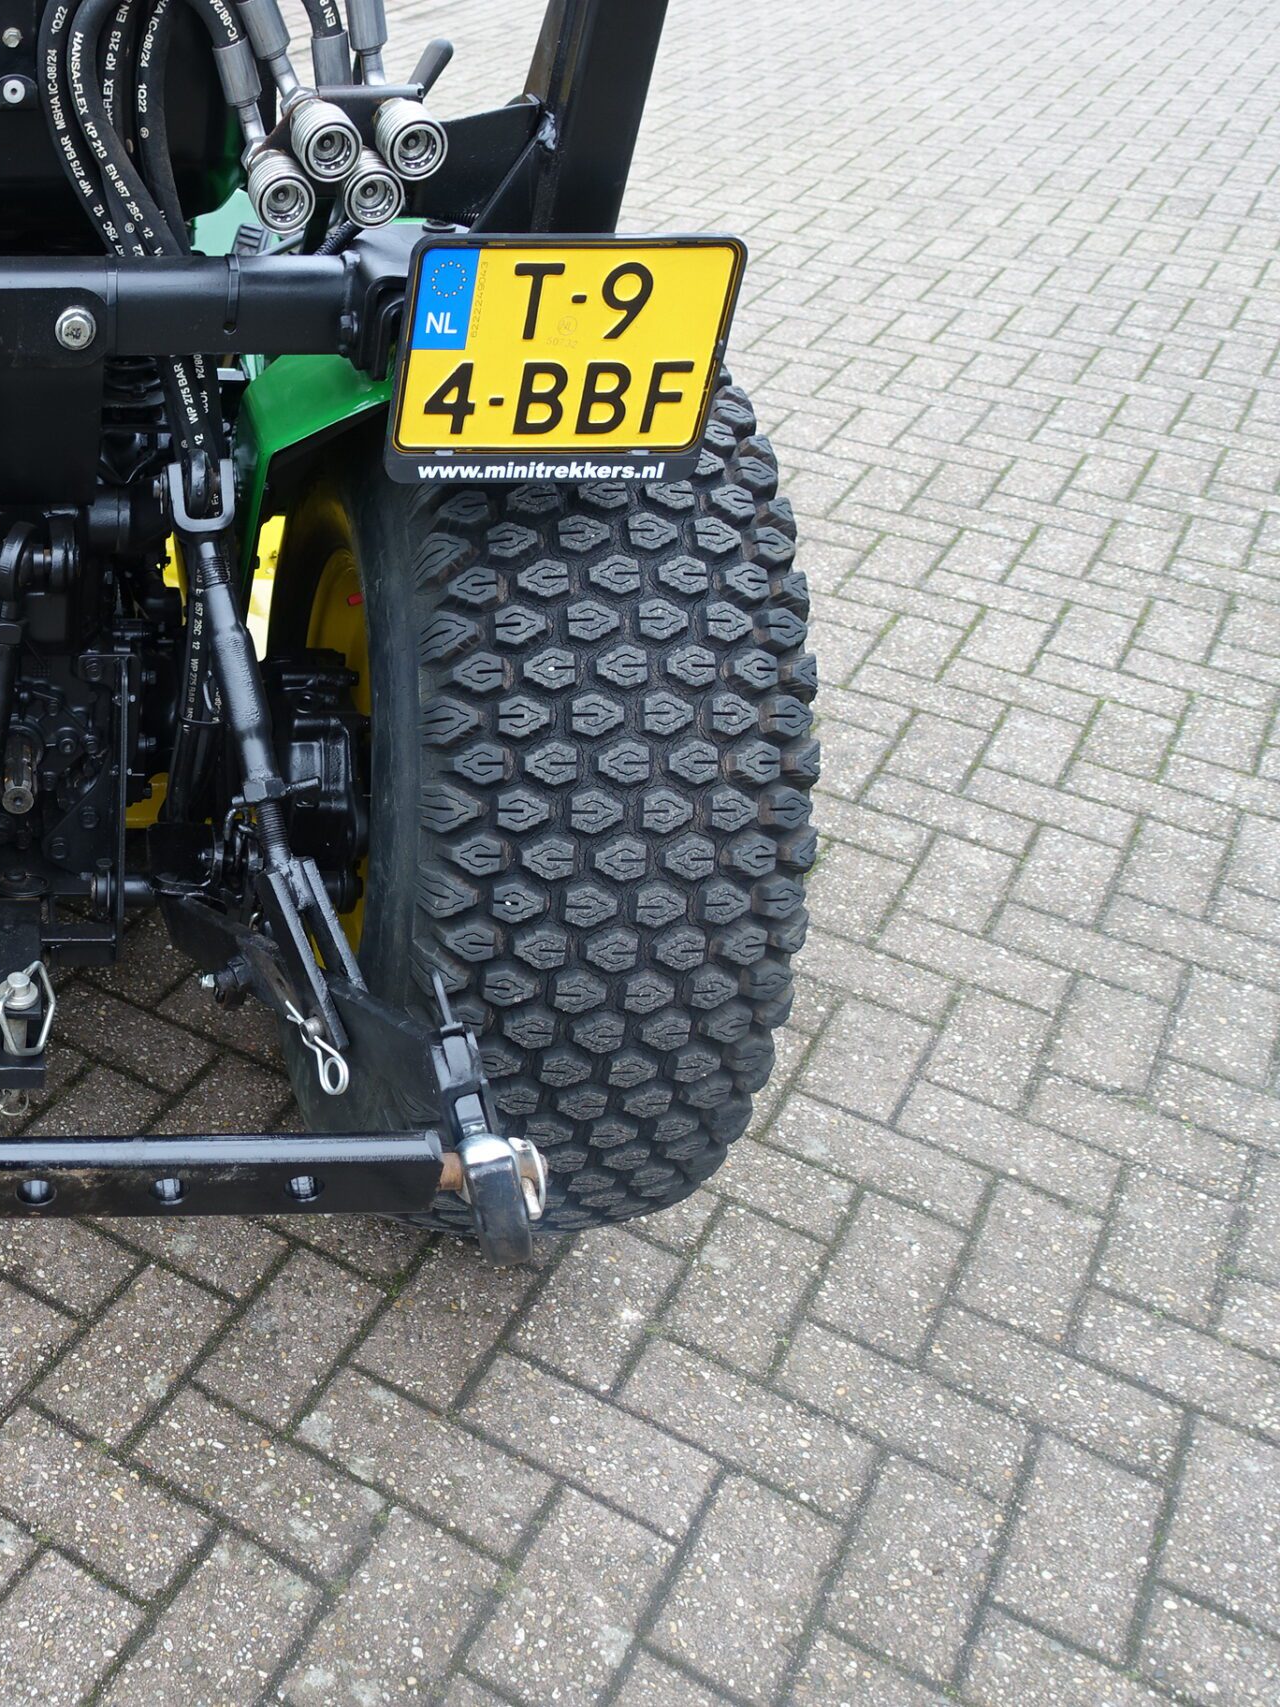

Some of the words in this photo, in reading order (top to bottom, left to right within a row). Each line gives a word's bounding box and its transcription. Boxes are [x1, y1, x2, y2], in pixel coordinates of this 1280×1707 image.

[51, 6, 68, 34] 1Q22
[116, 5, 129, 23] EN
[323, 7, 336, 27] EN
[109, 31, 121, 51] 213
[140, 16, 160, 68] IC-08/24
[106, 53, 117, 70] KP
[47, 49, 58, 95] IC-08/24
[138, 83, 147, 113] 1Q22
[50, 96, 66, 130] MSHA
[71, 31, 89, 115] HANSA-FLEX
[84, 121, 98, 139] KP
[92, 140, 107, 159] 213
[105, 163, 120, 181] EN
[114, 181, 130, 198] 857
[125, 201, 143, 221] 2SC
[142, 227, 154, 239] 12
[60, 135, 76, 160] BAR
[70, 160, 85, 178] 275
[78, 179, 94, 197] WP
[93, 204, 105, 217] 12
[102, 221, 119, 241] 2SC
[514, 262, 654, 340] T-9
[424, 312, 457, 334] NL
[174, 362, 188, 387] BAR
[193, 354, 205, 379] 08/24
[181, 386, 194, 405] 275
[424, 361, 695, 434] 4-BBF
[186, 406, 199, 425] WP
[418, 461, 665, 479] www.minitrekkers.nl
[194, 620, 202, 635] 2SC
[192, 641, 200, 650] 12
[191, 658, 199, 673] WP
